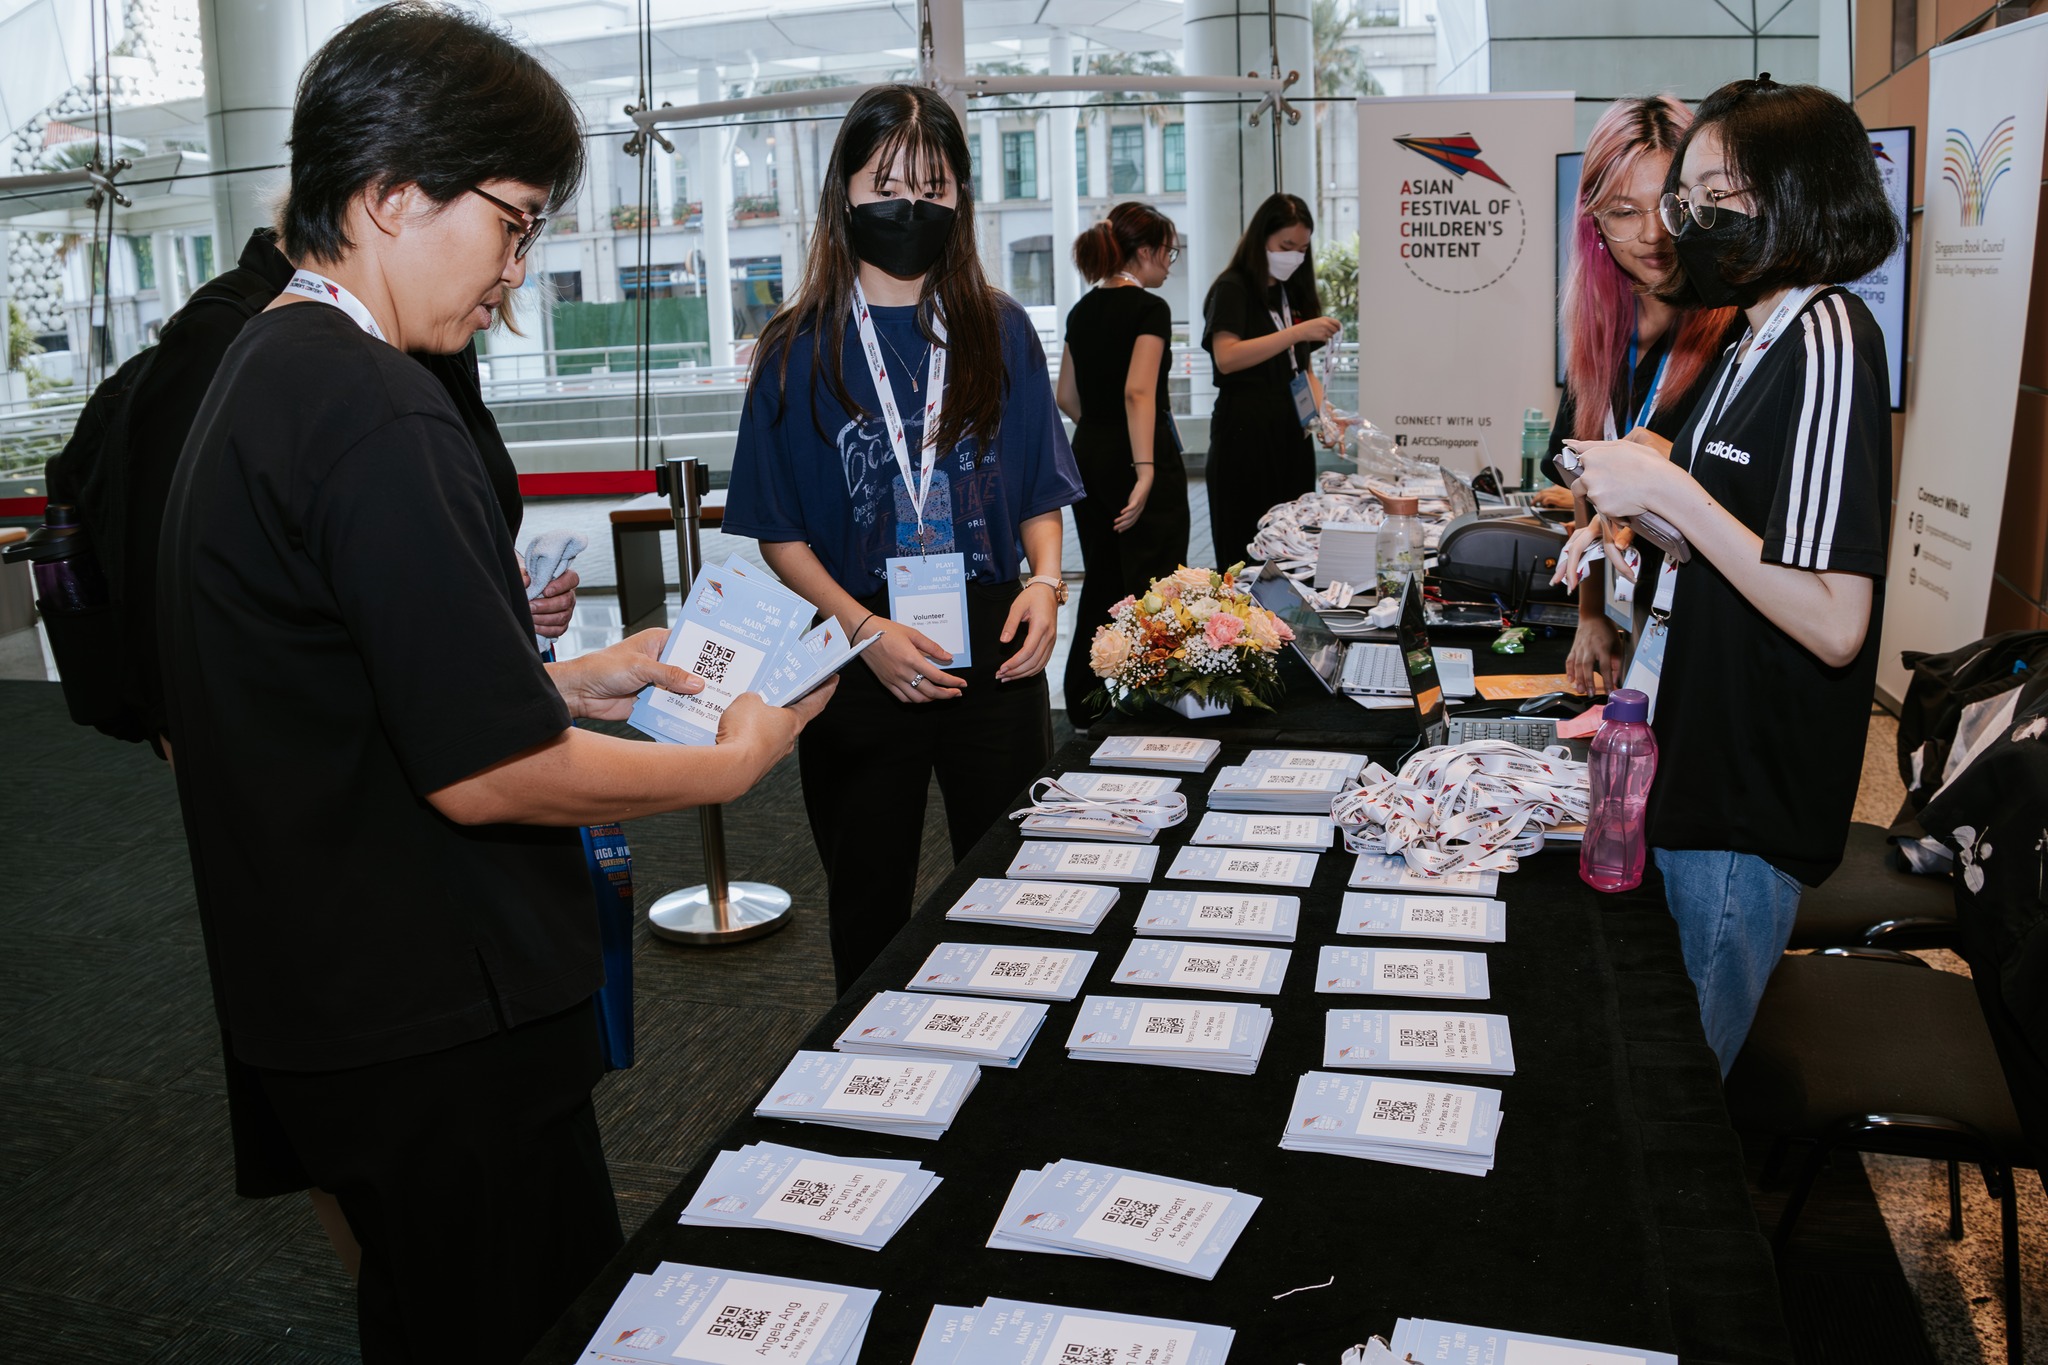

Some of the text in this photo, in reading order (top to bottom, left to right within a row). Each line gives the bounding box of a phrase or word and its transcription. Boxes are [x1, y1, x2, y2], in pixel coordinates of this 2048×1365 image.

[1400, 180, 1453, 196] ASIAN
[1400, 200, 1511, 216] FESTIVAL OF
[1400, 221, 1504, 237] CHILDREN'S
[1400, 242, 1481, 258] CONTENT
[1395, 416, 1492, 426] CONNECT WITH US
[1412, 436, 1479, 448] AFCCSingapore
[1705, 440, 1750, 464] adidas
[756, 600, 781, 616] PLAY!
[742, 617, 767, 632] MAIN!
[674, 700, 685, 709] May
[706, 713, 719, 722] 2023
[705, 702, 713, 710] 25
[1024, 977, 1038, 986] Eng
[961, 1012, 989, 1039] Don Bosco
[987, 1016, 998, 1025] Pass
[1444, 1021, 1456, 1057] Wan Ting Neo
[882, 1089, 904, 1107] Cheng
[900, 1068, 914, 1078] Lim
[906, 1087, 918, 1095] Day
[911, 1076, 923, 1086] Pass
[1443, 1093, 1453, 1102] May
[1417, 1093, 1436, 1134] Vidhya Rajagopal
[1439, 1109, 1448, 1121] Pass:
[1436, 1122, 1447, 1131] Day
[818, 1207, 839, 1221] Bee
[845, 1174, 864, 1188] Lim
[847, 1198, 862, 1208] Day
[855, 1185, 871, 1197] Pass
[1145, 1198, 1186, 1242] Leo Vincent
[1172, 1221, 1187, 1232] Day
[1180, 1207, 1196, 1221] Pass
[654, 1275, 678, 1297] PLAY!
[676, 1284, 699, 1306] MAIN!
[755, 1302, 802, 1356] Angela Ang
[784, 1328, 800, 1341] Day
[793, 1311, 810, 1327] Pass
[794, 1339, 808, 1350] May
[808, 1316, 822, 1327] May
[815, 1302, 829, 1316] 2023
[941, 1320, 958, 1344] PLAY!
[989, 1312, 1009, 1336] PLAY!
[1015, 1321, 1034, 1345] MAIN!
[1126, 1343, 1143, 1360] Aw
[1166, 1338, 1177, 1352] 2023
[1436, 1336, 1451, 1360] PLAY!
